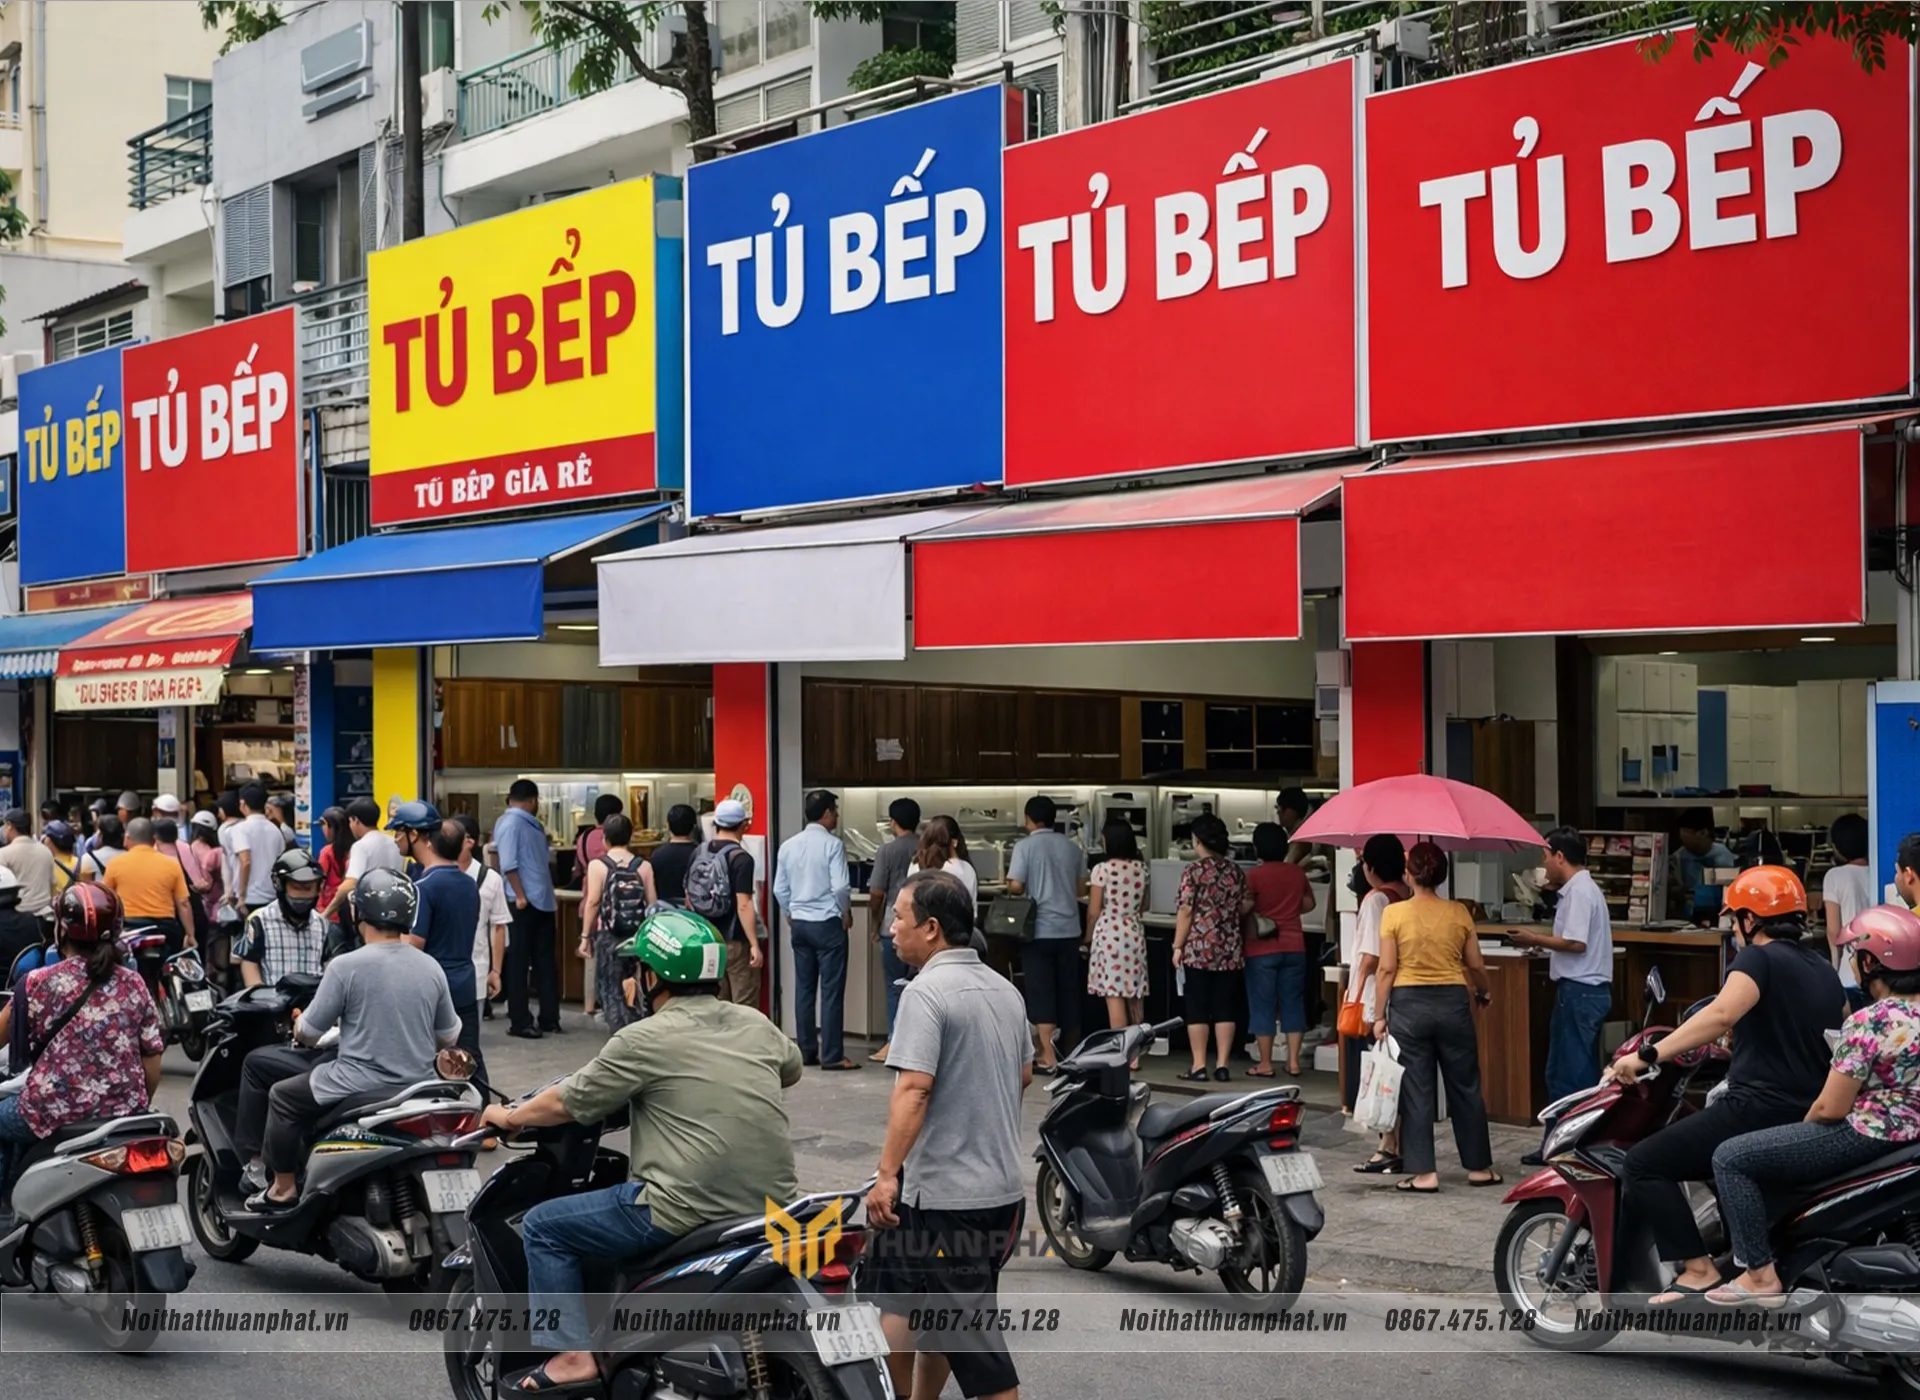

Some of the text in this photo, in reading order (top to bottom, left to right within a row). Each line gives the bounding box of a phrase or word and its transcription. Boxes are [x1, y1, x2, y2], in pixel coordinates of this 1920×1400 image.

[707, 148, 987, 335] TỦ BẾP
[1018, 127, 1329, 322] TỦ BẾP
[1419, 61, 1843, 289] TỦ BẾP
[132, 343, 288, 471] TỦ BẾP
[383, 276, 468, 413] TỦ
[24, 385, 121, 483] TỦ BẾP
